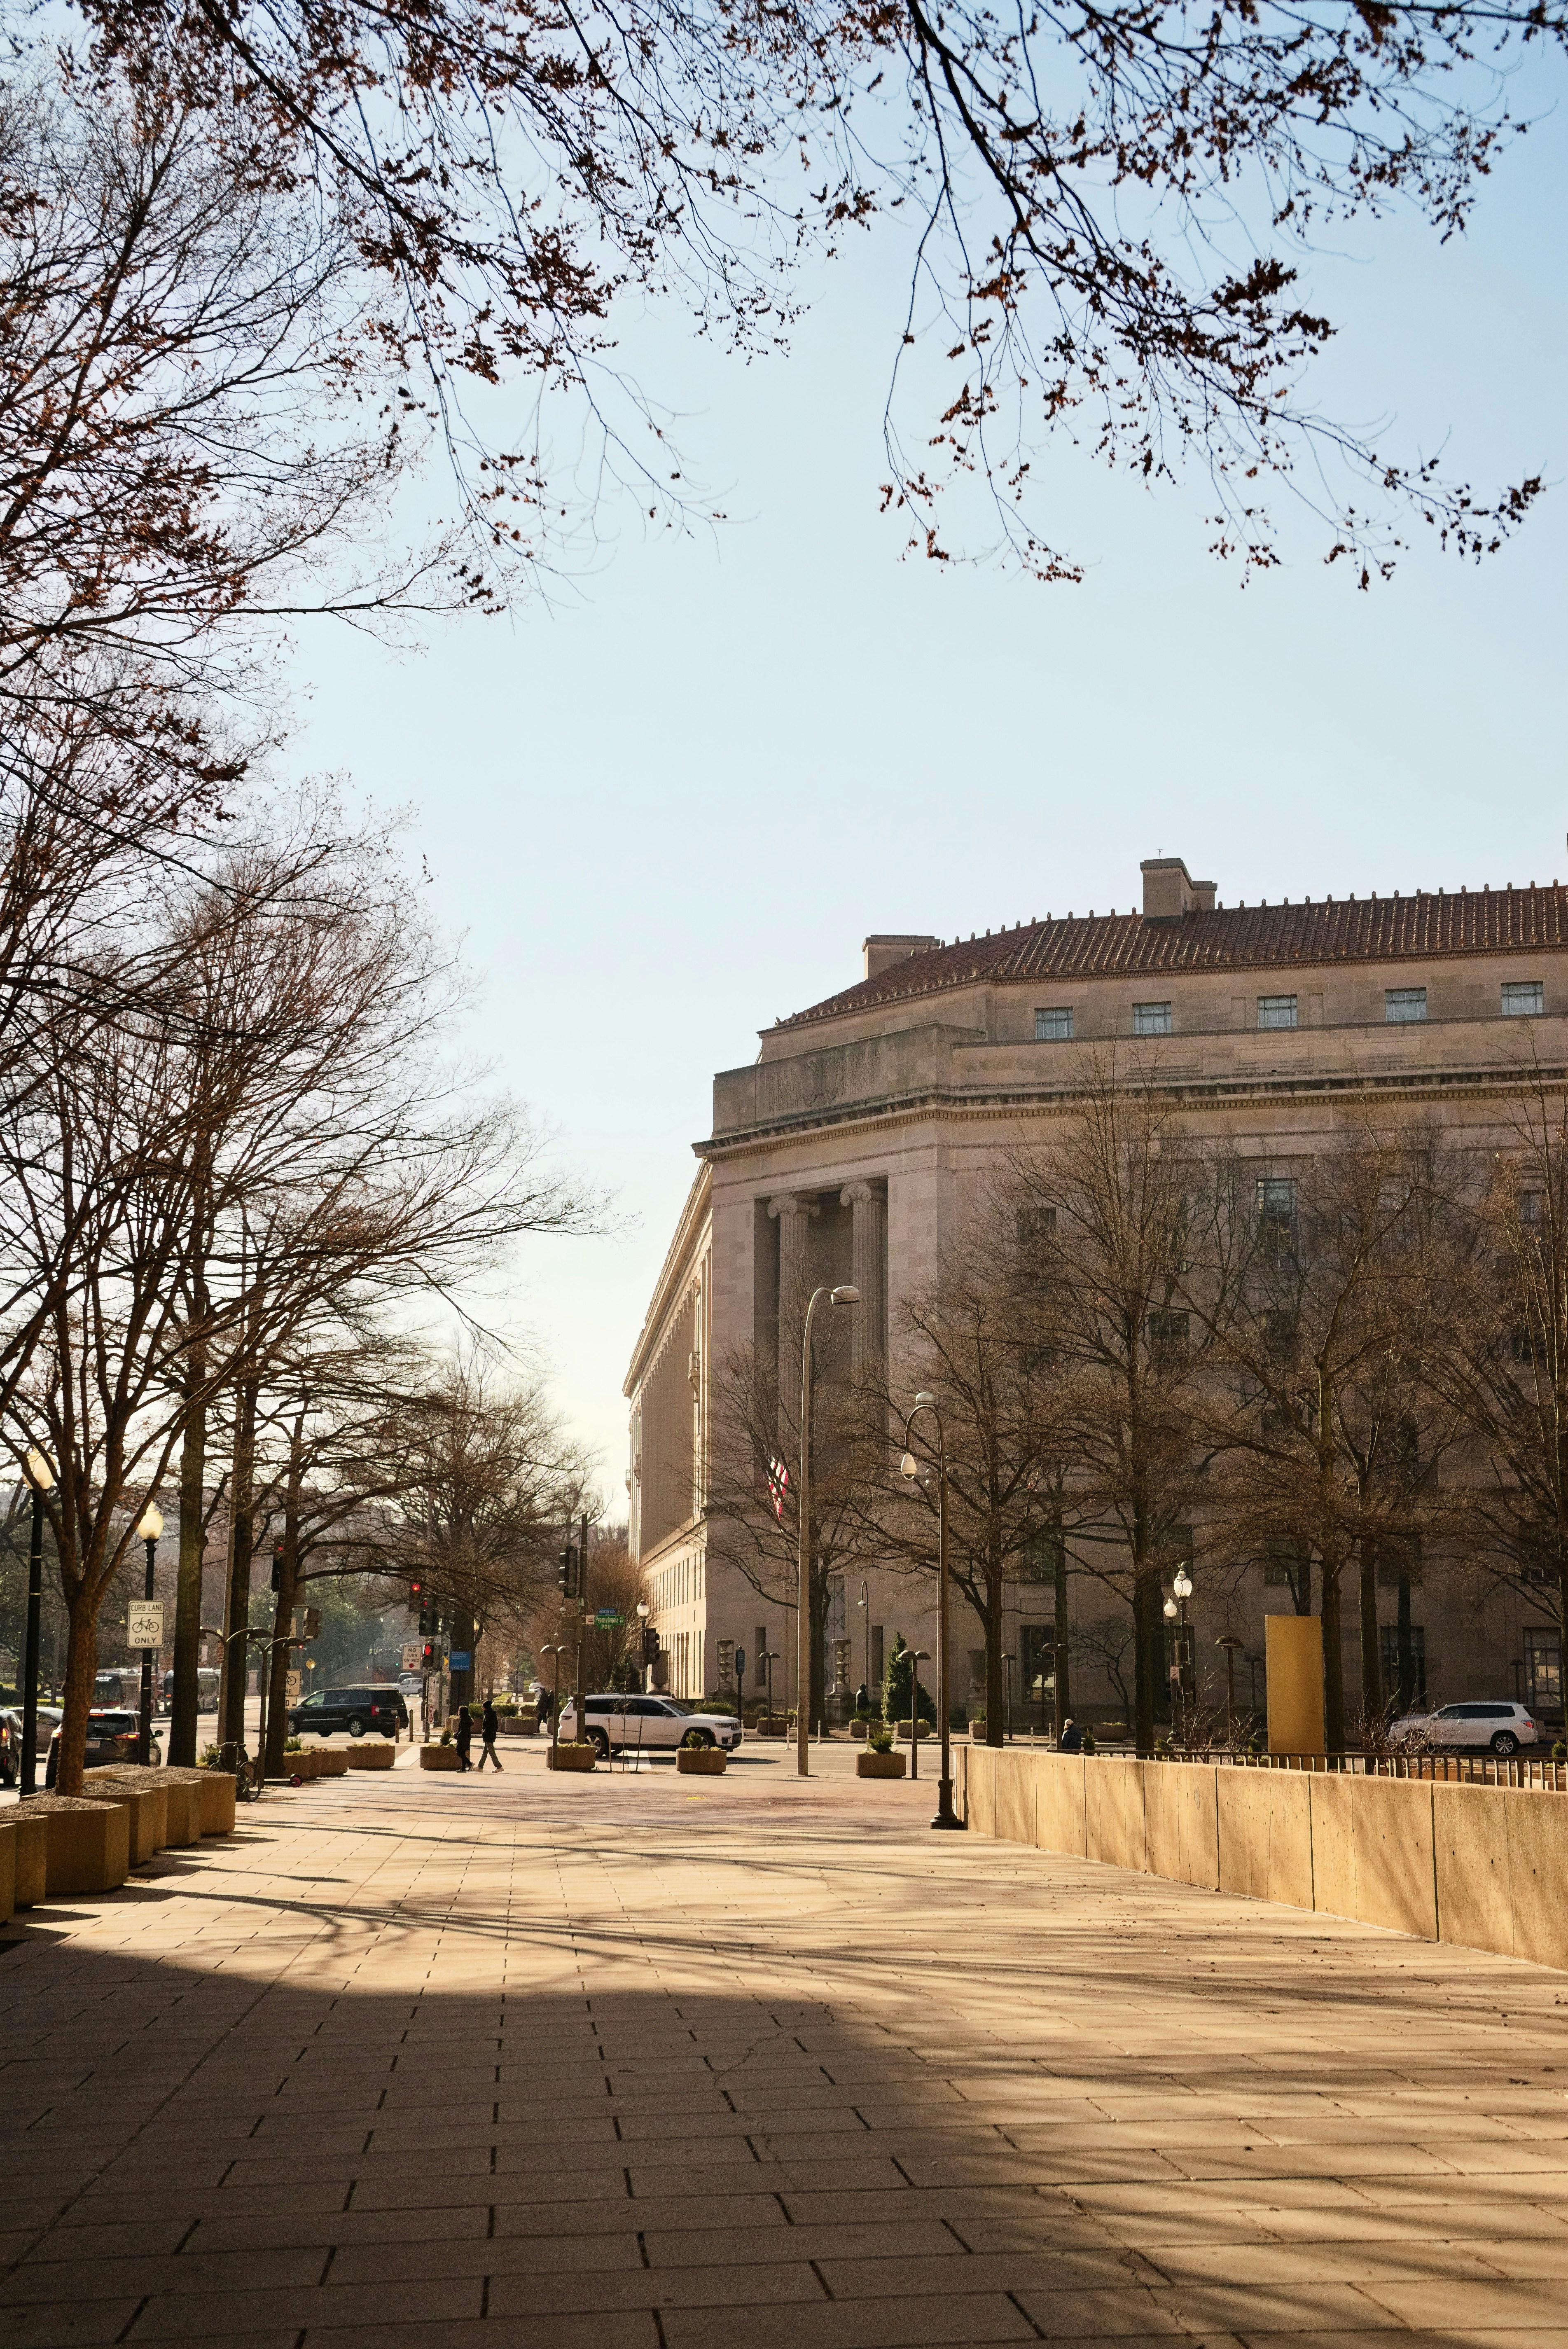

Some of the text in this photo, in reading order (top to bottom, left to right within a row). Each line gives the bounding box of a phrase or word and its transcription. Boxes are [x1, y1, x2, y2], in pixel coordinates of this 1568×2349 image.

[842, 1051, 871, 1064] FOUNDED
[874, 1049, 881, 1058] IN
[842, 1057, 881, 1073] BESTOWED
[778, 1083, 802, 1094] NATURE
[839, 1071, 856, 1081] UPON
[838, 1089, 846, 1098] OF
[849, 1083, 874, 1096] JUSTICE
